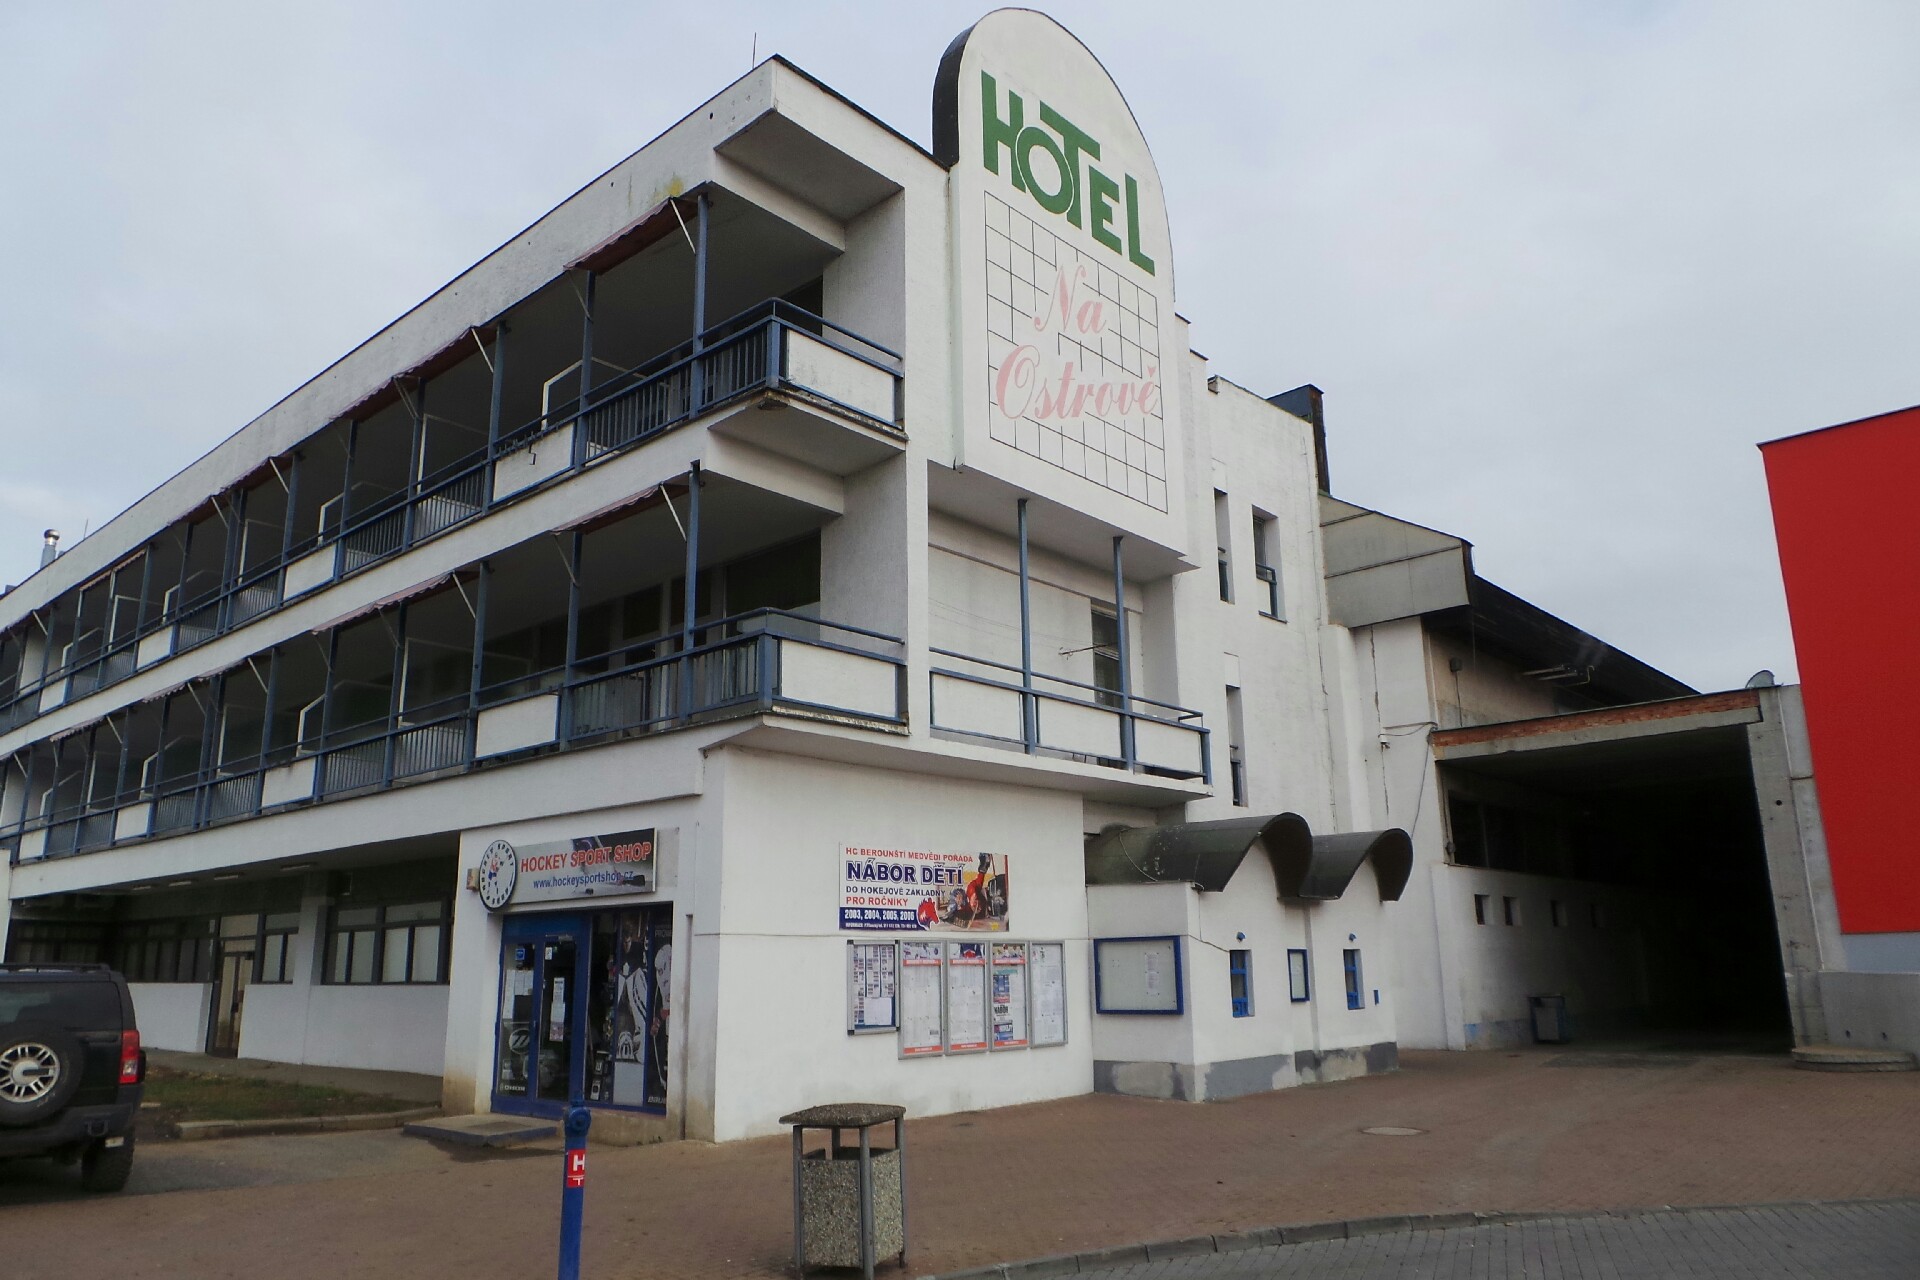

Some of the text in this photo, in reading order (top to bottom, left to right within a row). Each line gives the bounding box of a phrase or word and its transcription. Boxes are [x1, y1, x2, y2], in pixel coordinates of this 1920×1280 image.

[981, 69, 1156, 276] HOTEL
[1033, 264, 1107, 336] Na
[995, 344, 1159, 422] Ostrově
[521, 841, 652, 873] HOCKEY SPORT SHOP
[846, 847, 858, 855] HC
[533, 870, 634, 889] www.hockeysportshop.cz
[846, 858, 965, 887] NÁBOR DĚTÍ
[846, 896, 865, 905] PRO
[860, 886, 904, 896] HOKEJOVÉ
[845, 909, 863, 920] 2003,
[573, 1153, 586, 1172] H
